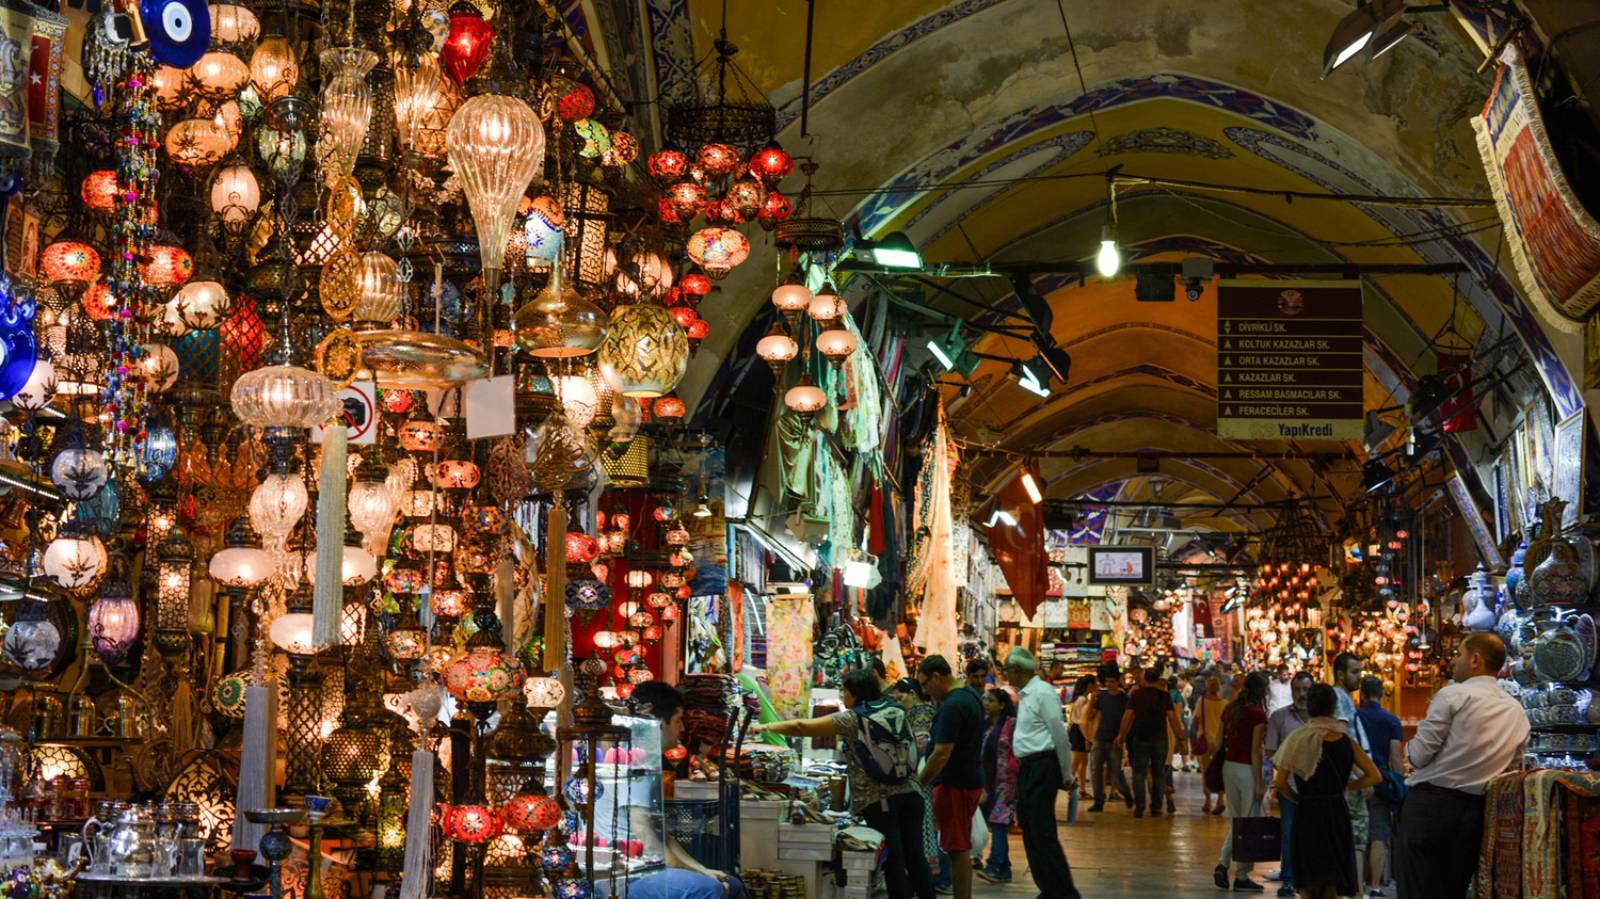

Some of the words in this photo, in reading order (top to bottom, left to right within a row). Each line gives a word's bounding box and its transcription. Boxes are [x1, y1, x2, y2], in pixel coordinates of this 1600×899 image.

[1274, 324, 1286, 332] SK.
[1239, 340, 1271, 348] KOLTUK
[1273, 340, 1315, 348] KAZAZLAR
[1317, 341, 1330, 349] SK.
[1239, 357, 1260, 365] ORTA
[1263, 357, 1305, 365] KAZAZLAR
[1307, 357, 1320, 365] SK.
[1239, 373, 1281, 382] KAZAZLAR
[1283, 374, 1295, 382] SK.
[1239, 390, 1272, 399] RESSAM
[1274, 391, 1326, 399] BASMACILAR
[1328, 391, 1341, 399] SK.
[1239, 405, 1294, 415] FERACECİLER
[1296, 407, 1309, 415] SK.
[1279, 423, 1332, 437] YapıKredi
